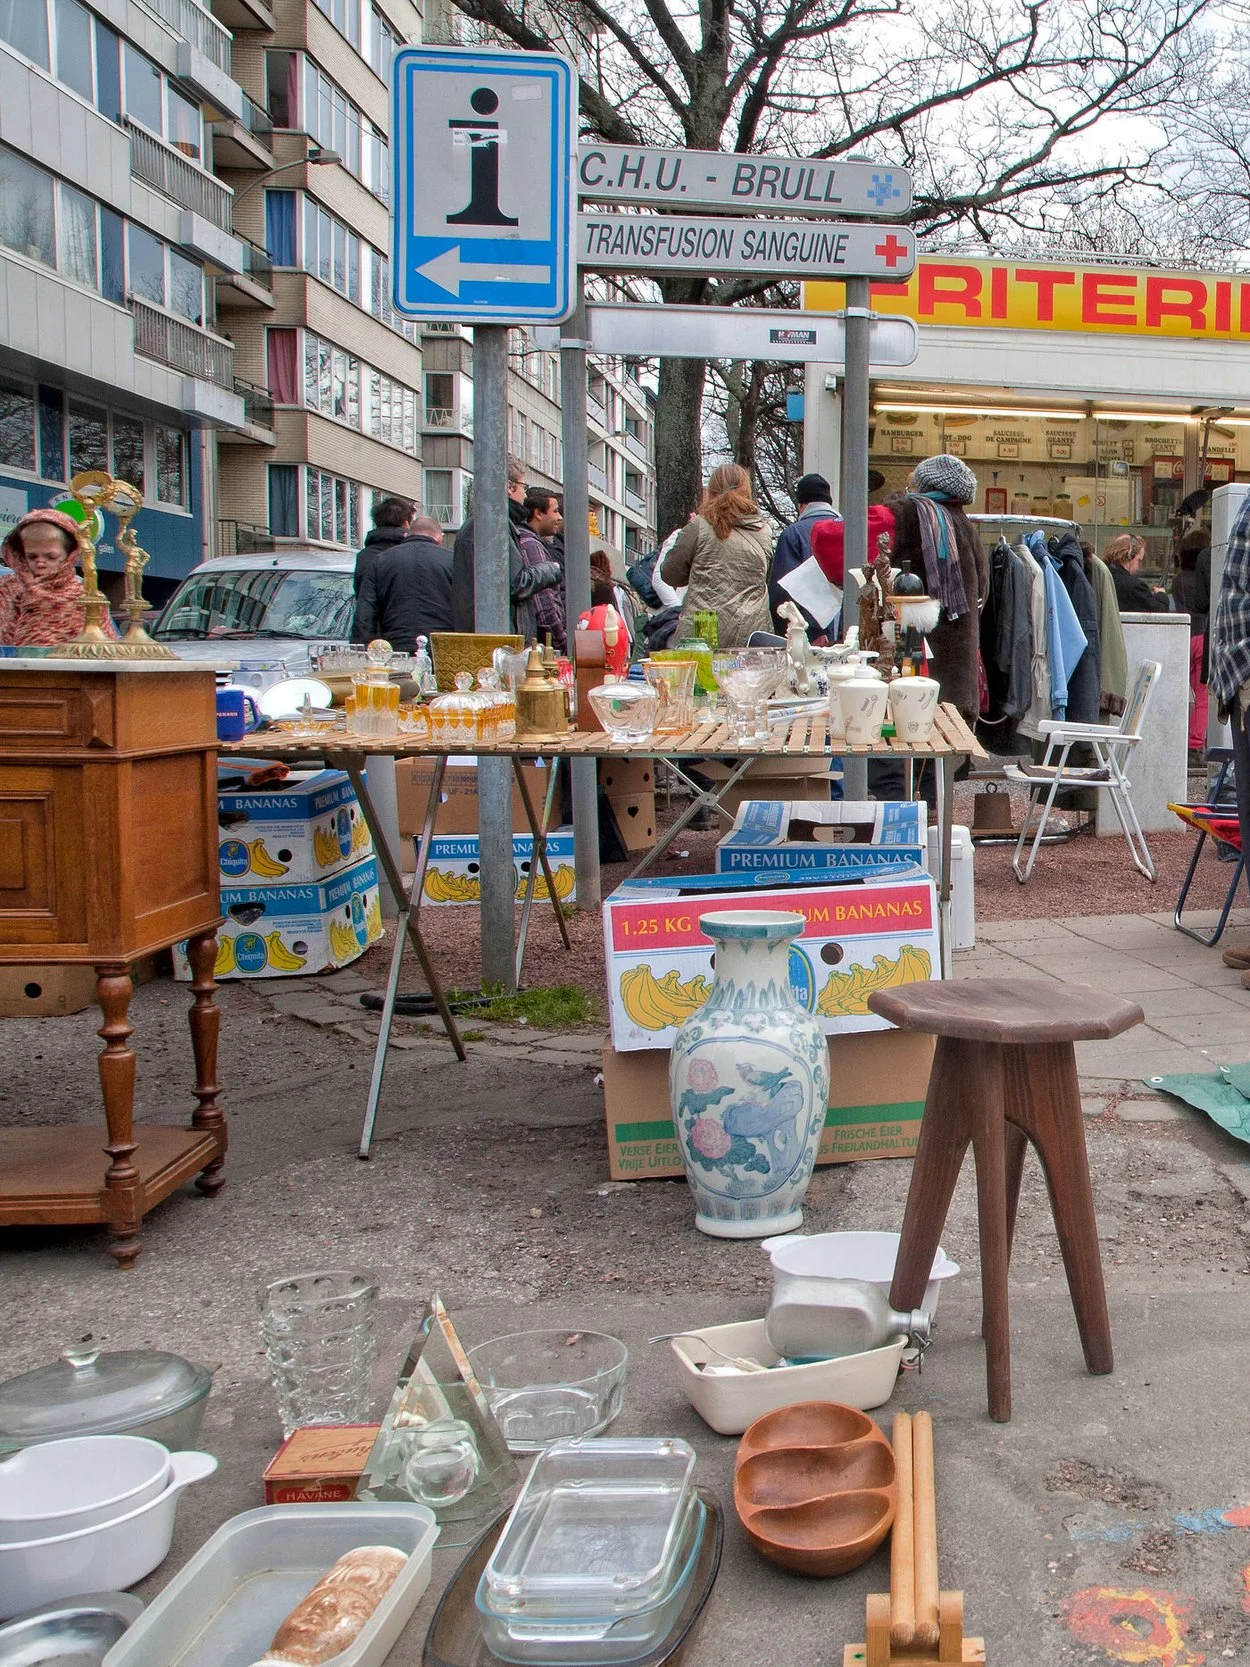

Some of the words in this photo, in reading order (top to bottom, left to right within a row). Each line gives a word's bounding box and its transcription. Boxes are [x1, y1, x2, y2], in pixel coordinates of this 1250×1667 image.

[580, 152, 687, 193] C.H.U.
[732, 163, 842, 204] BRULL
[586, 223, 734, 258] TRANSFUSION
[741, 231, 849, 264] SANGUINE
[236, 797, 298, 810] BANANAS
[435, 843, 479, 855] PREMIU
[512, 841, 560, 854] ANAAS
[731, 853, 816, 868] PREMIUM
[826, 852, 912, 867] BANANAS
[249, 888, 313, 902] BANANAS
[835, 900, 923, 921] BANANAS
[622, 919, 659, 937] 1.25
[664, 916, 692, 933] KG
[834, 1126, 878, 1140] FRISCHE
[880, 1126, 903, 1138] EIER
[620, 1145, 653, 1157] VERSE
[618, 1158, 645, 1172] VRIJE
[286, 1490, 342, 1501] HAVANE
